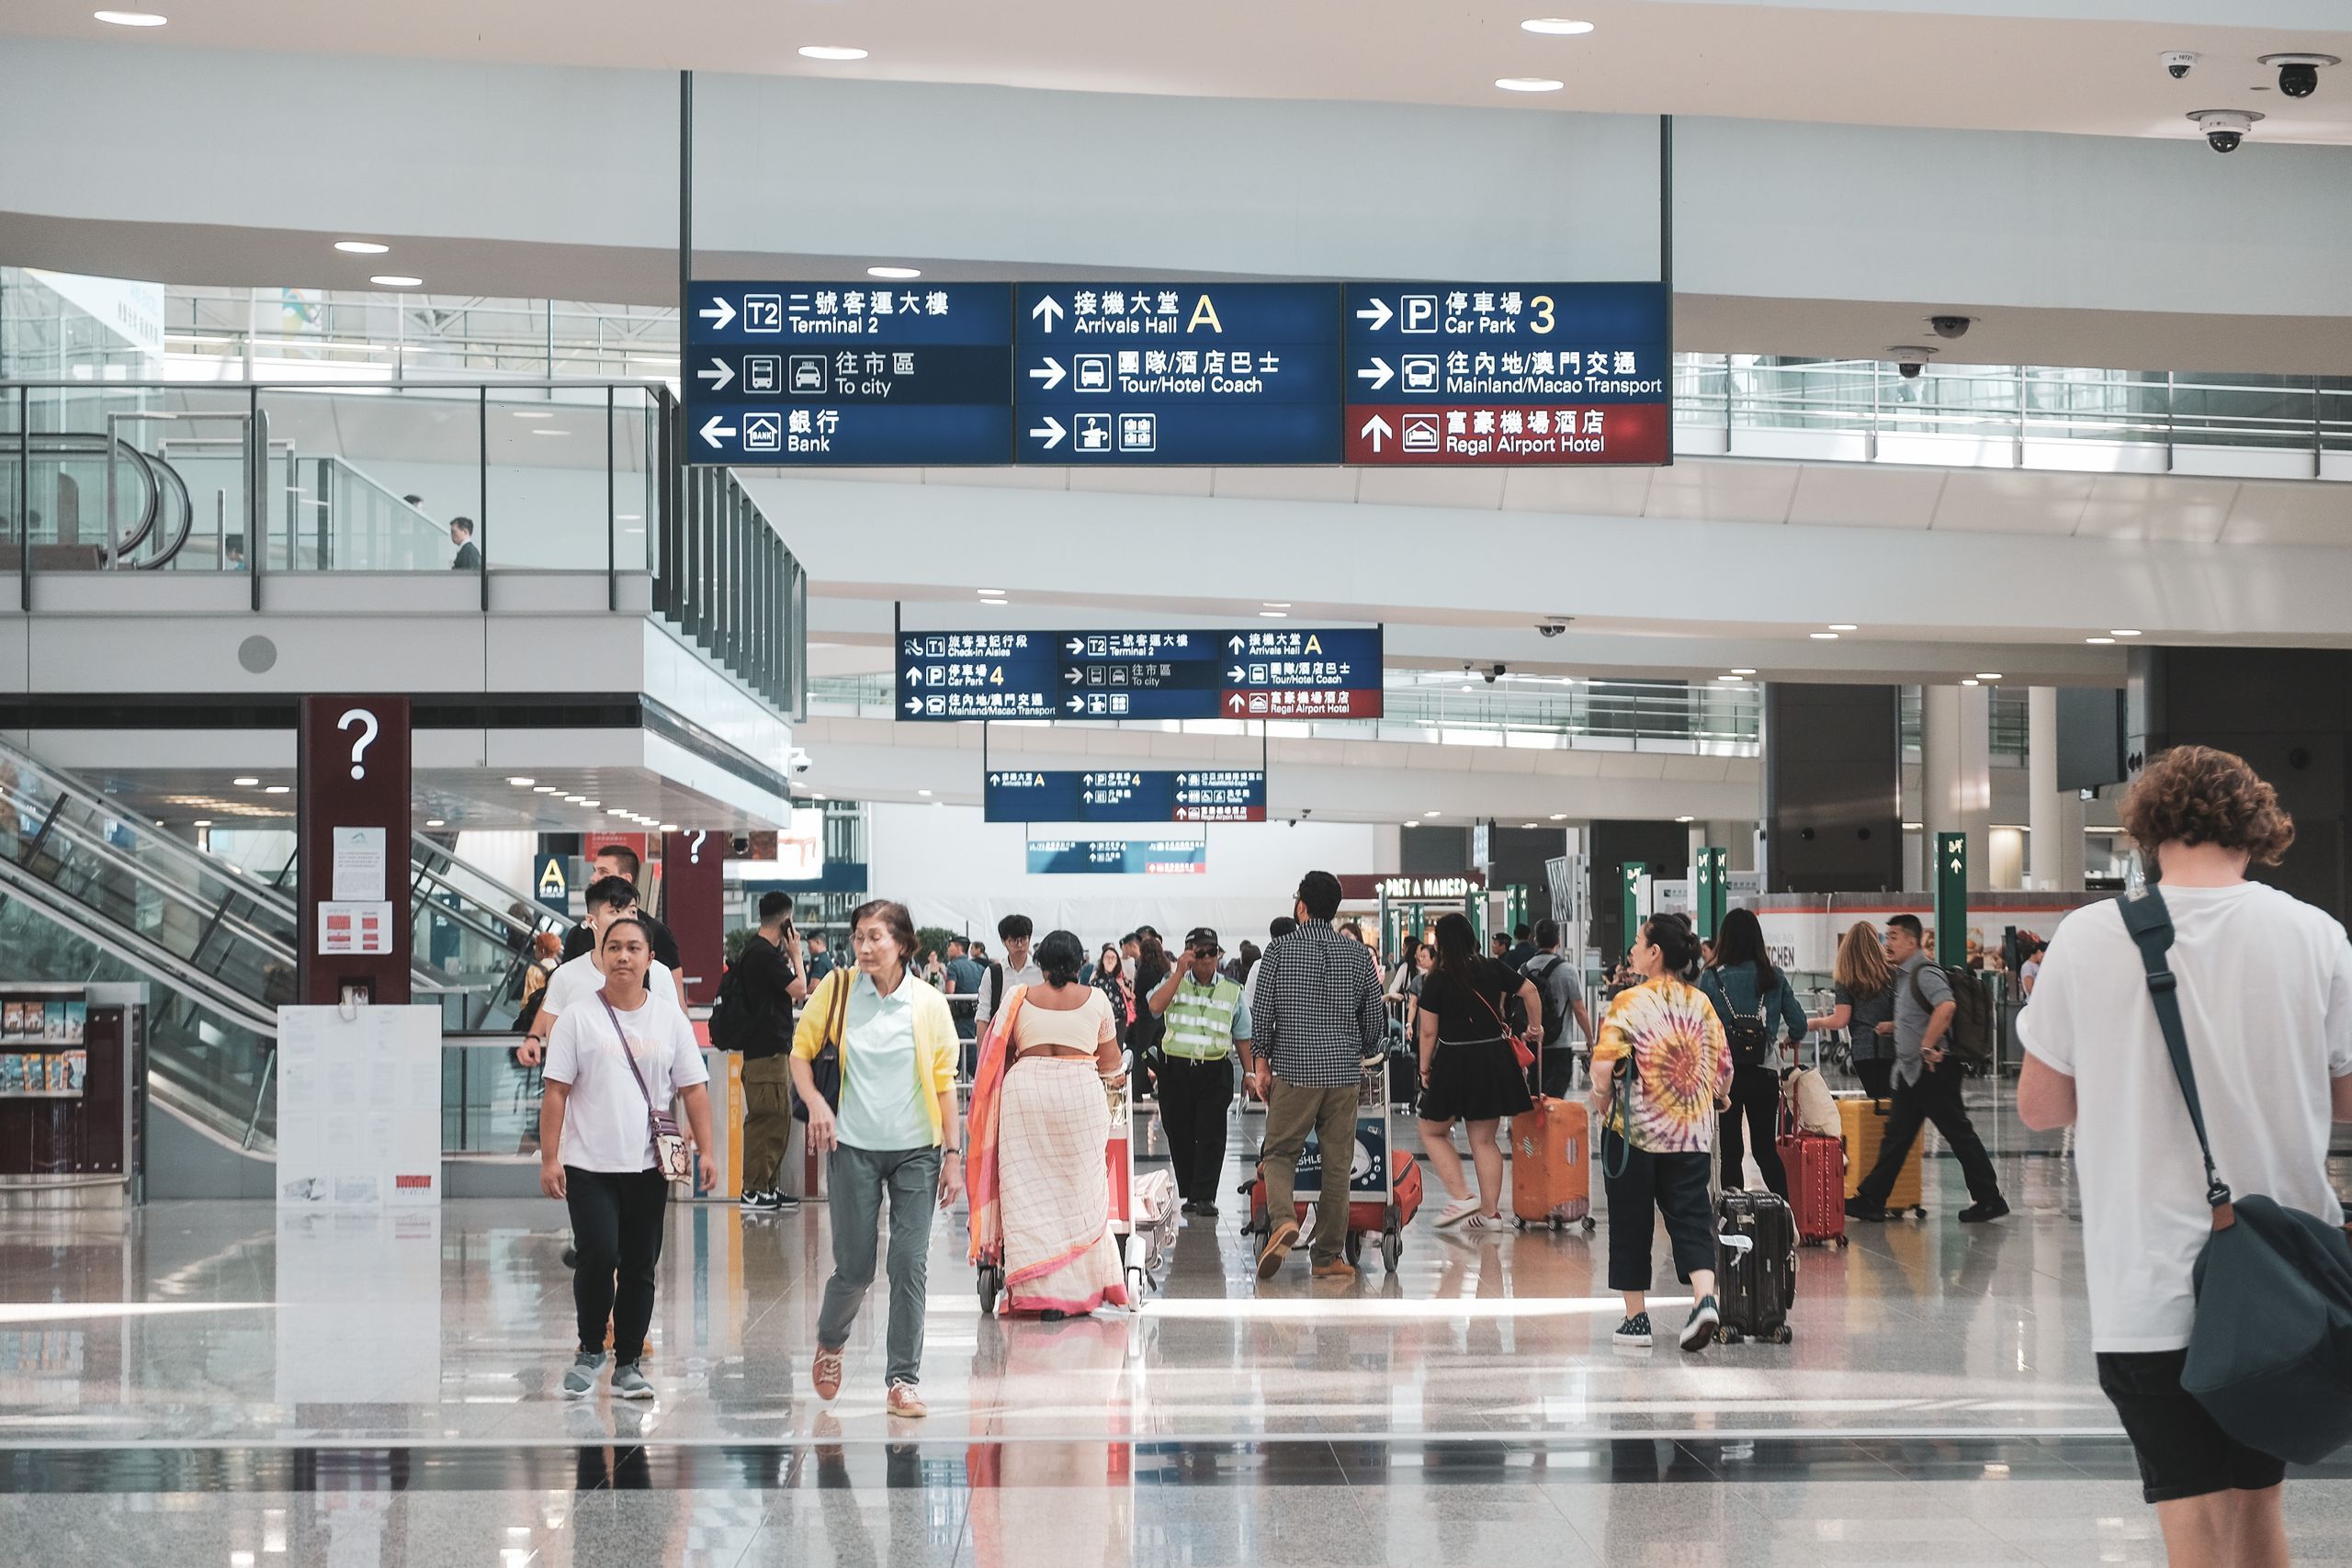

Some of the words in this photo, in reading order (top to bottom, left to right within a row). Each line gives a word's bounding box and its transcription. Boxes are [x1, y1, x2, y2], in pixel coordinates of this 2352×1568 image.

[788, 290, 949, 316] 二號客運大樓
[1074, 290, 1180, 315] 接機大堂
[1445, 291, 1523, 316] 停車場
[748, 302, 778, 325] T2
[1187, 294, 1223, 333] A
[1530, 295, 1555, 334] 3
[788, 317, 863, 333] Terminal
[867, 317, 878, 333] 2
[1074, 317, 1140, 333] Arrivals
[1146, 317, 1177, 333] Hall
[1445, 317, 1475, 333] Car
[1479, 317, 1516, 333] Park
[834, 351, 915, 376] 往市區
[835, 378, 855, 395] To
[861, 378, 891, 398] city
[1119, 377, 1205, 393] Tour/Hotel
[1211, 377, 1262, 393] Coach
[1446, 377, 1582, 394] Mainland/Macao
[1585, 377, 1662, 396] Transport
[788, 409, 840, 434] 銀行
[1446, 410, 1604, 435] 富豪機場酒店
[787, 435, 831, 452] Bank
[1446, 435, 1492, 456] Regal
[1497, 435, 1555, 456] Airport
[1561, 435, 1605, 452] Hotel
[1090, 639, 1105, 652] T2
[1109, 646, 1146, 656] Terminal
[1148, 646, 1154, 656] 2
[1250, 645, 1282, 655] Arrivals
[1283, 645, 1300, 655] Hall
[1304, 634, 1323, 655] A
[947, 676, 963, 686] Car
[965, 676, 984, 686] Park
[989, 665, 1004, 686] 4
[1132, 676, 1142, 686] To
[1144, 676, 1160, 687] city
[1271, 674, 1314, 684] Tour/Hotel
[1316, 674, 1342, 684] Coach
[948, 705, 1016, 716] Mainland/Macao
[1017, 705, 1056, 716] Transport
[1271, 703, 1294, 715] Regal
[1295, 703, 1325, 715] Airport
[1327, 703, 1350, 714] Hotel
[1034, 773, 1045, 787] A
[539, 858, 566, 886] A
